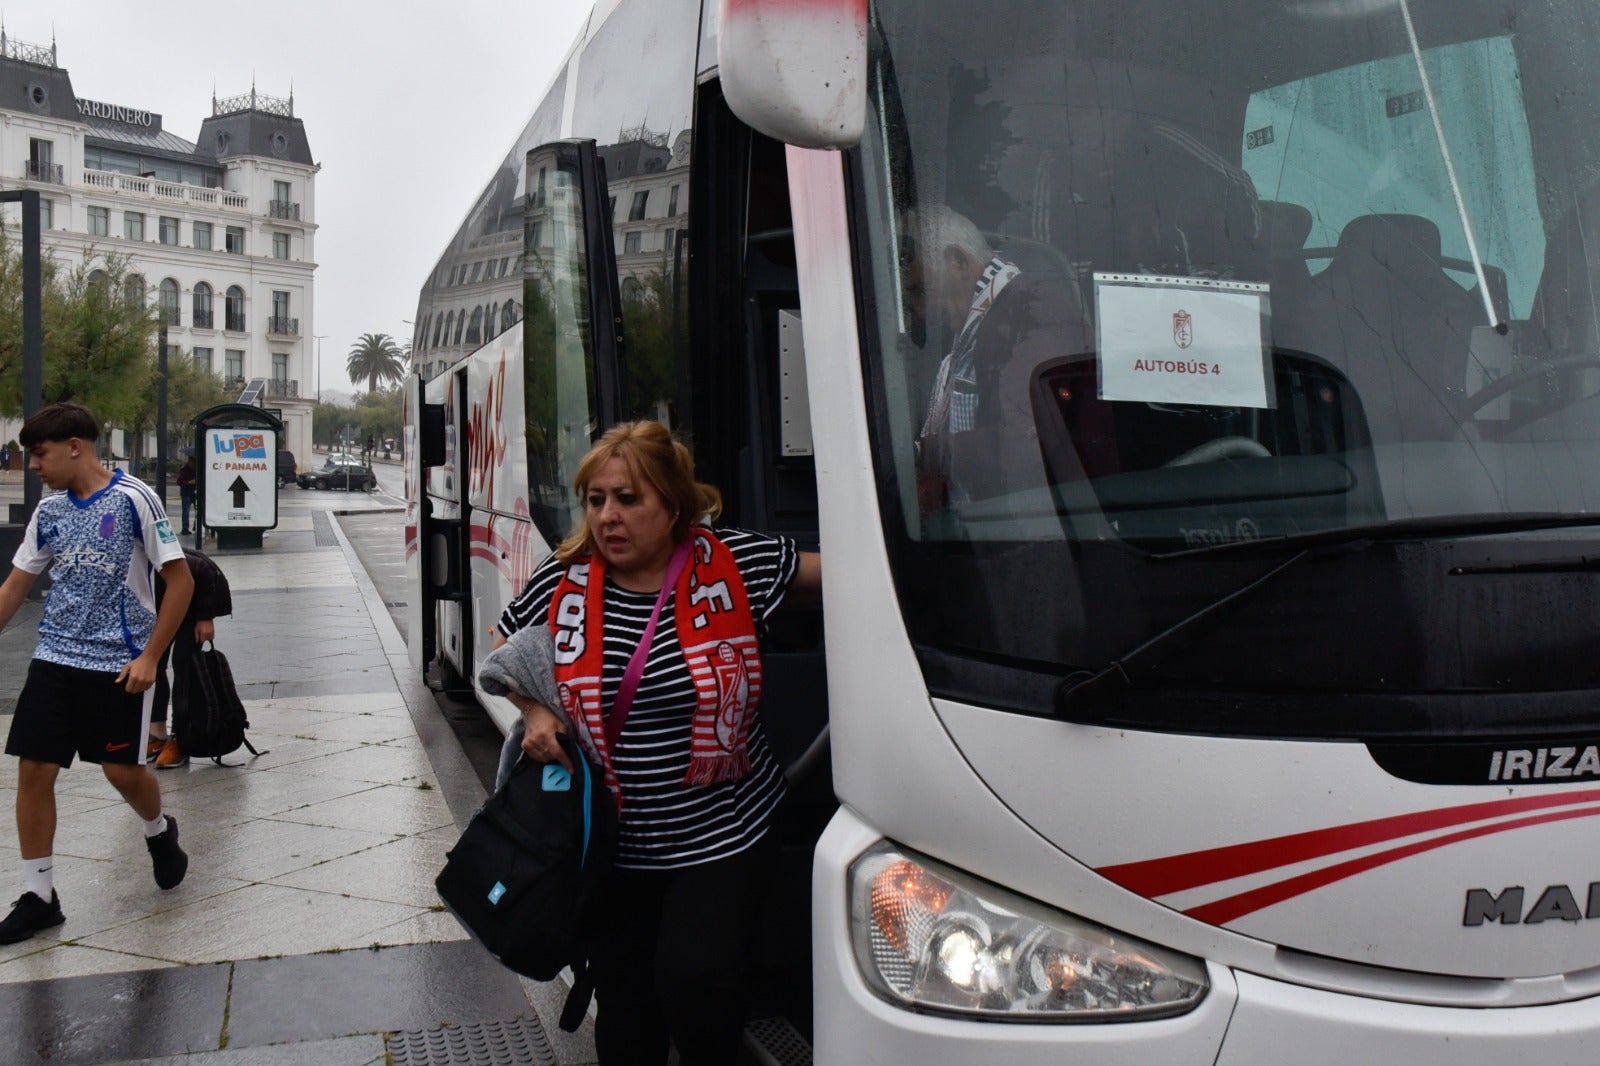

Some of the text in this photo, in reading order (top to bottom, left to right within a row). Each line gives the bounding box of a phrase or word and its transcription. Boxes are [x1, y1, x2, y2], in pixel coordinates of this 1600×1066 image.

[1134, 358, 1221, 375] AUTOBÚS 4
[213, 434, 264, 457] lupa
